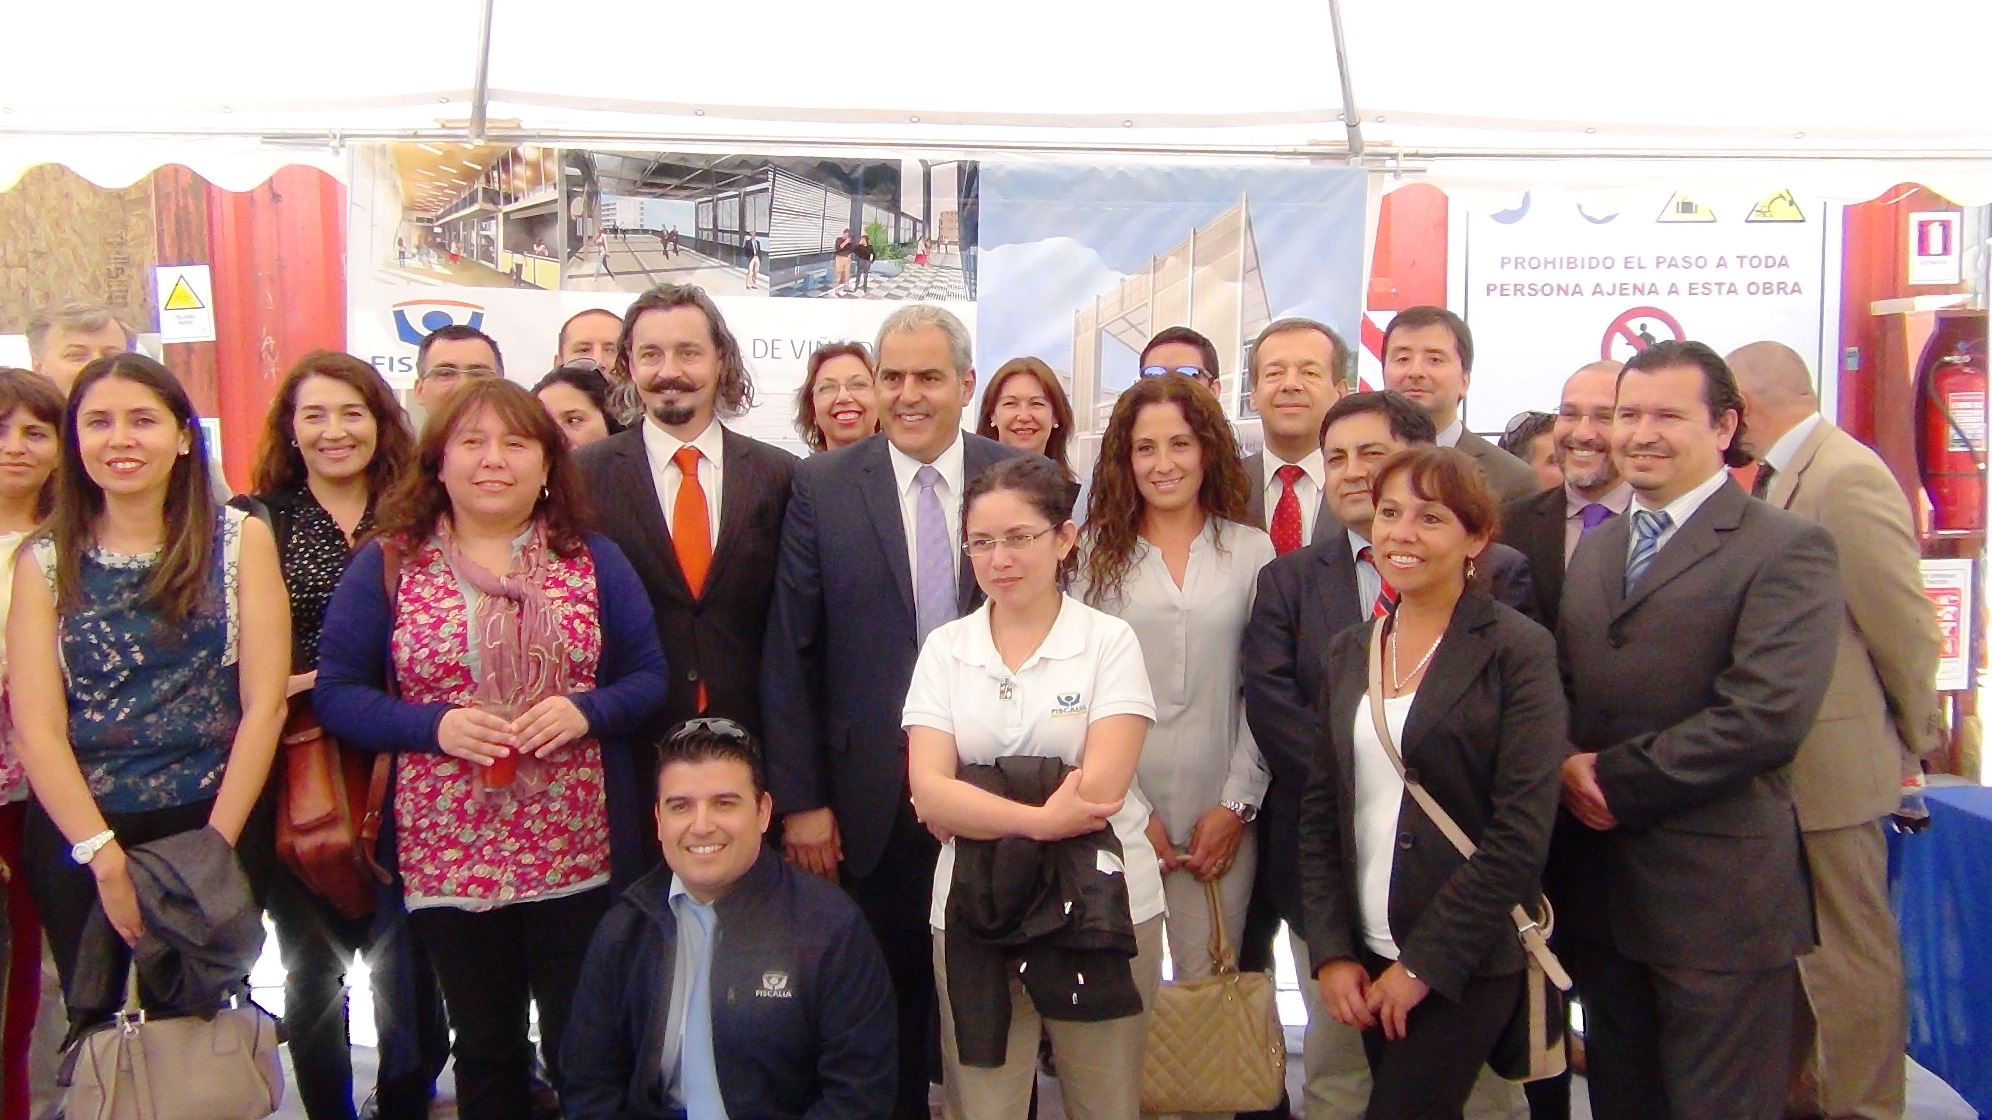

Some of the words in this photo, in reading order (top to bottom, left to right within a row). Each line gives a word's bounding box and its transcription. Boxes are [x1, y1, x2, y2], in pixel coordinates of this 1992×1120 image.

[1500, 256, 1615, 270] PROHIBIDO
[1623, 255, 1647, 270] EL
[1655, 255, 1708, 269] PASO
[1715, 255, 1729, 269] A
[1735, 254, 1790, 269] TODA
[1486, 283, 1584, 297] PERSONA
[1591, 282, 1660, 297] AJENA
[1667, 282, 1681, 296] A
[1688, 281, 1739, 296] ESTA
[1746, 281, 1803, 295] OBRA
[752, 338, 783, 360] DE
[370, 355, 414, 373] FIS
